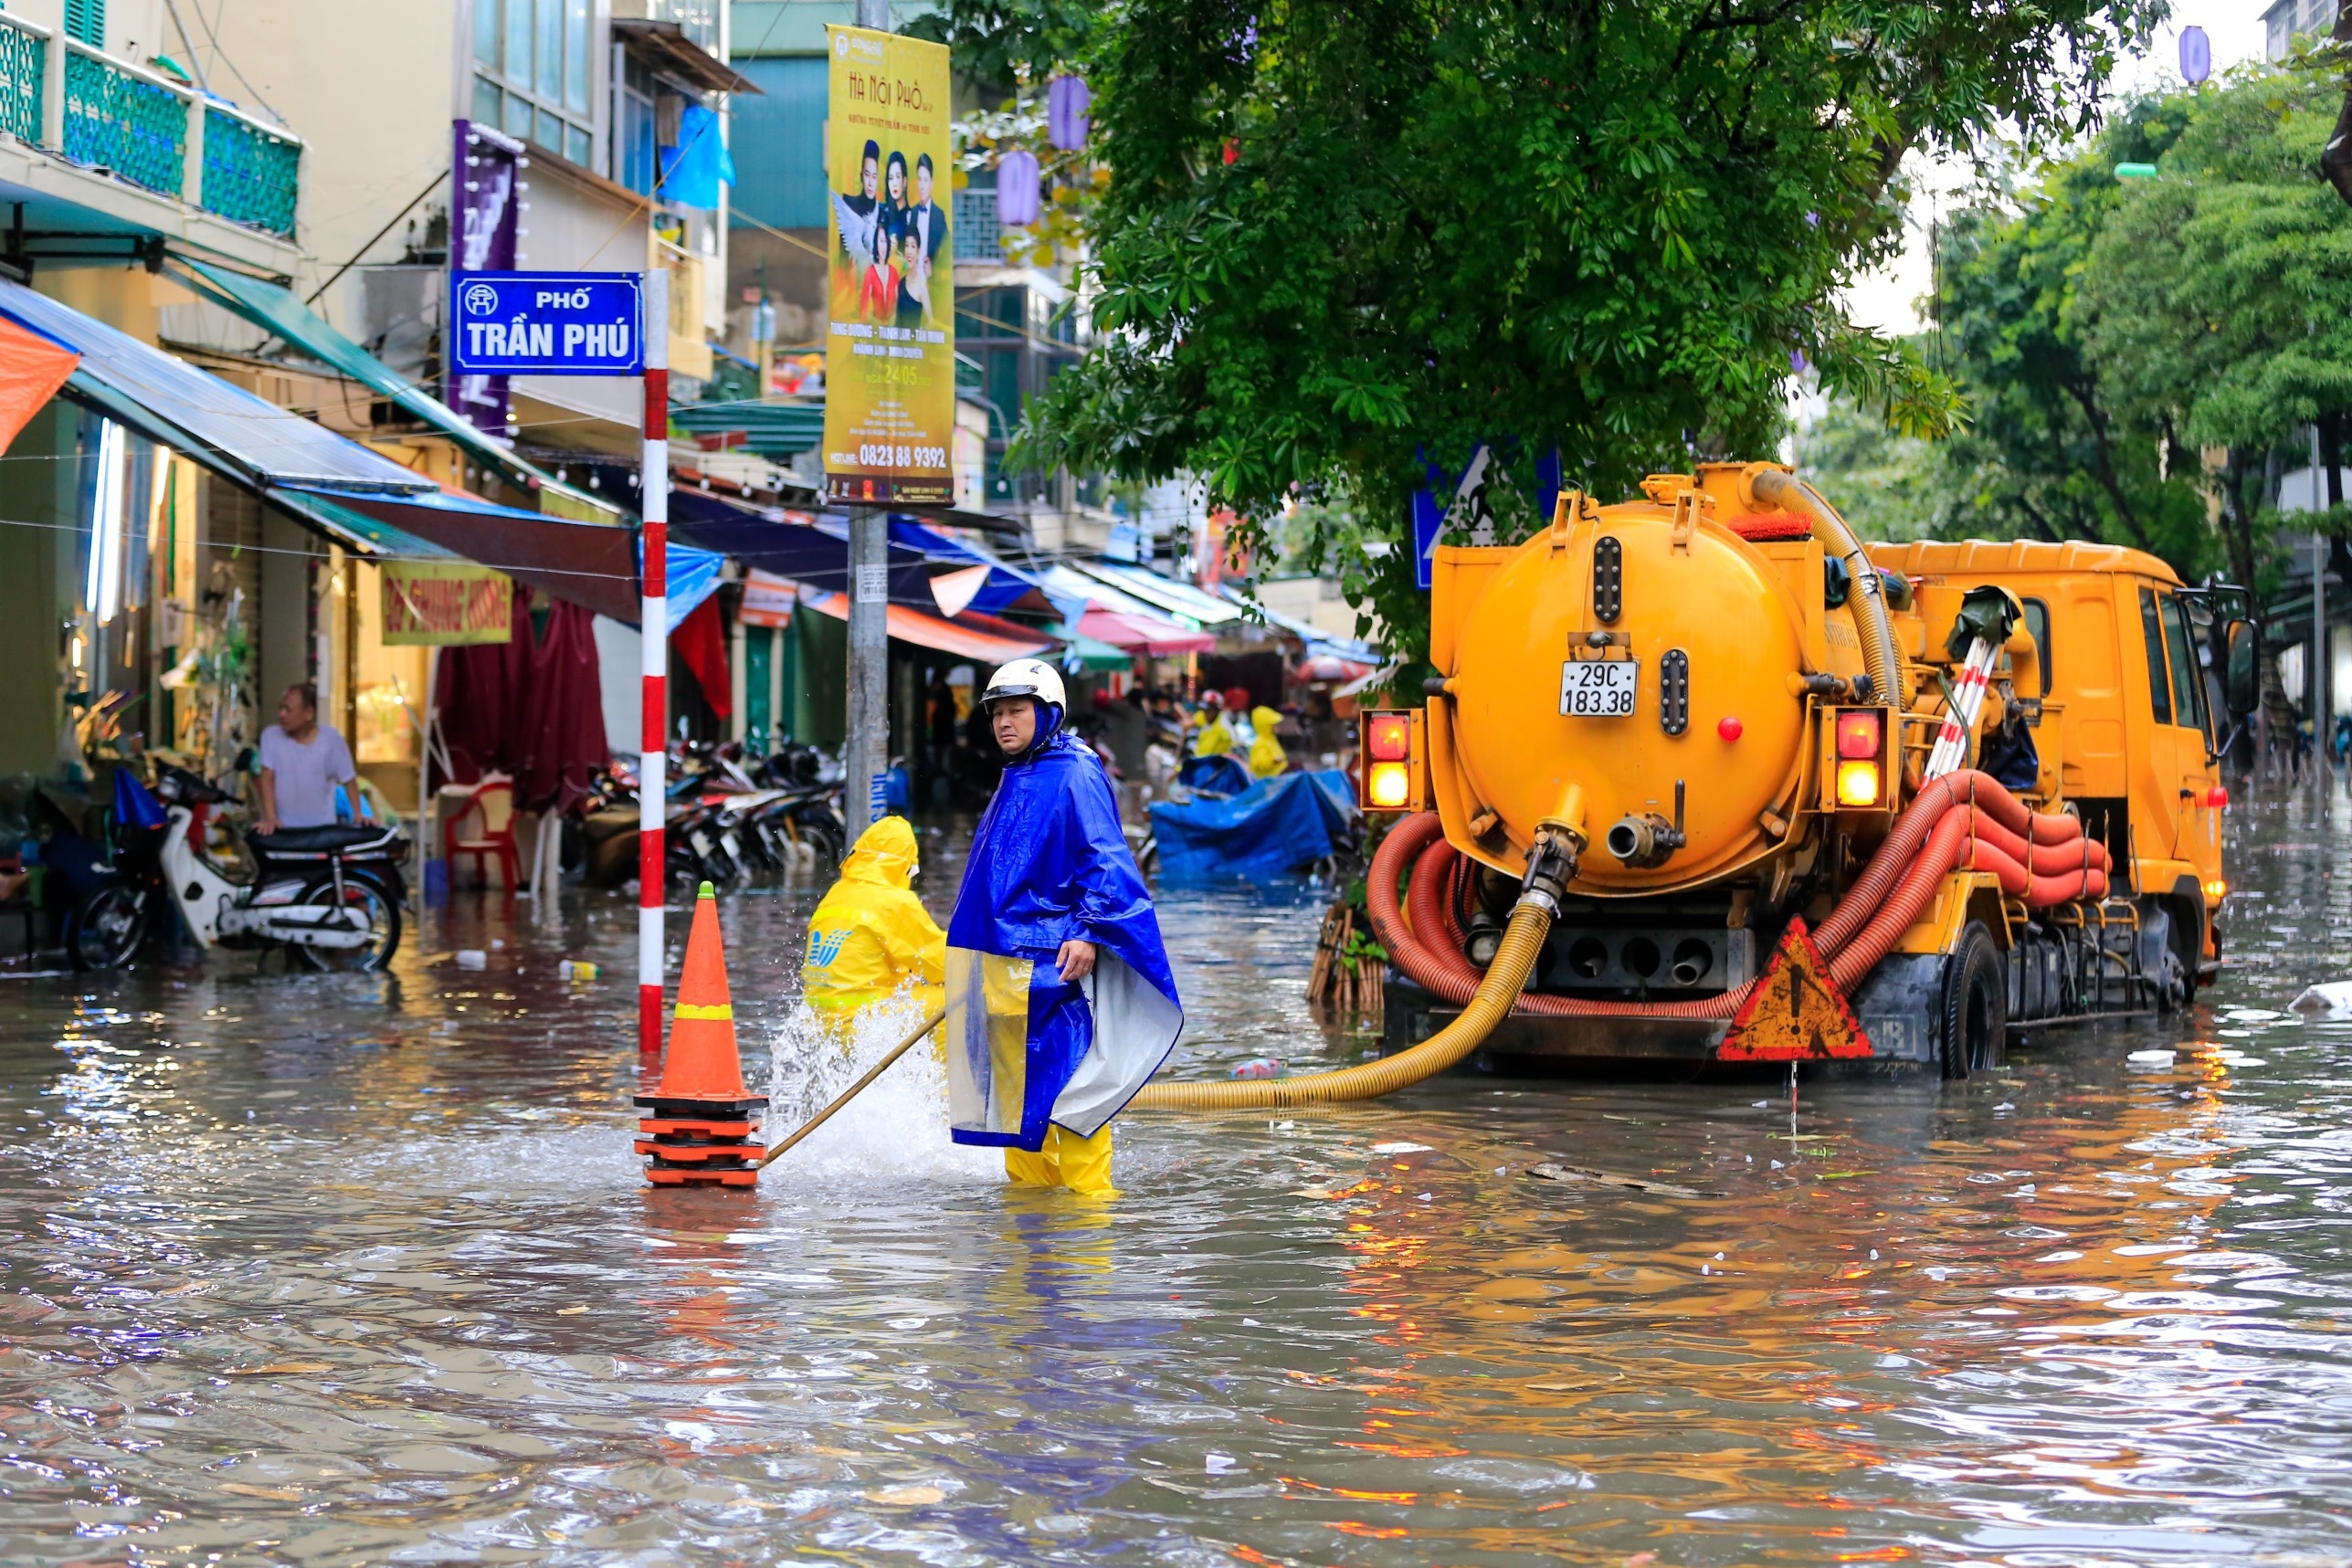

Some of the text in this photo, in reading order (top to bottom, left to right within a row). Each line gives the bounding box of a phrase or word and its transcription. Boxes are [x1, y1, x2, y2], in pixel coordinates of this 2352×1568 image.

[849, 71, 864, 100] HÀ
[870, 75, 891, 109] NỘI
[897, 79, 923, 110] PHỐ
[536, 287, 593, 310] PHỐ
[467, 312, 629, 358] TRẦN PHÚ
[860, 444, 894, 467] 0823
[896, 446, 911, 467] 88
[914, 446, 946, 468] 9392
[1579, 665, 1619, 687] 29C
[1566, 689, 1632, 713] 183.38
